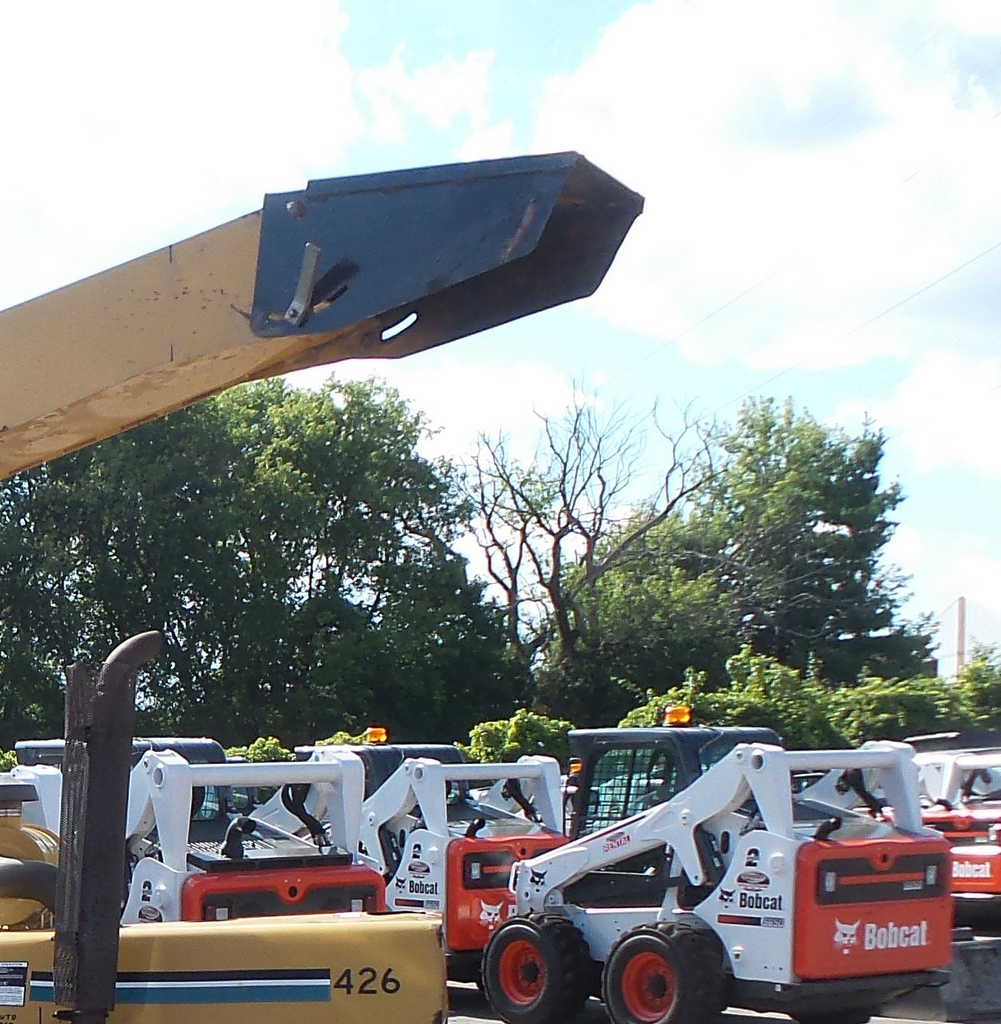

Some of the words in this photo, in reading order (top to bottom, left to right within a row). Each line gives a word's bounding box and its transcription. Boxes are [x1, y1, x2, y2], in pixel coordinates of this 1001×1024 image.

[950, 861, 992, 878] Bobcat
[409, 880, 438, 895] Bobcat
[739, 892, 783, 911] Bobcat
[864, 920, 928, 950] Bobcat
[333, 967, 401, 995] 426
